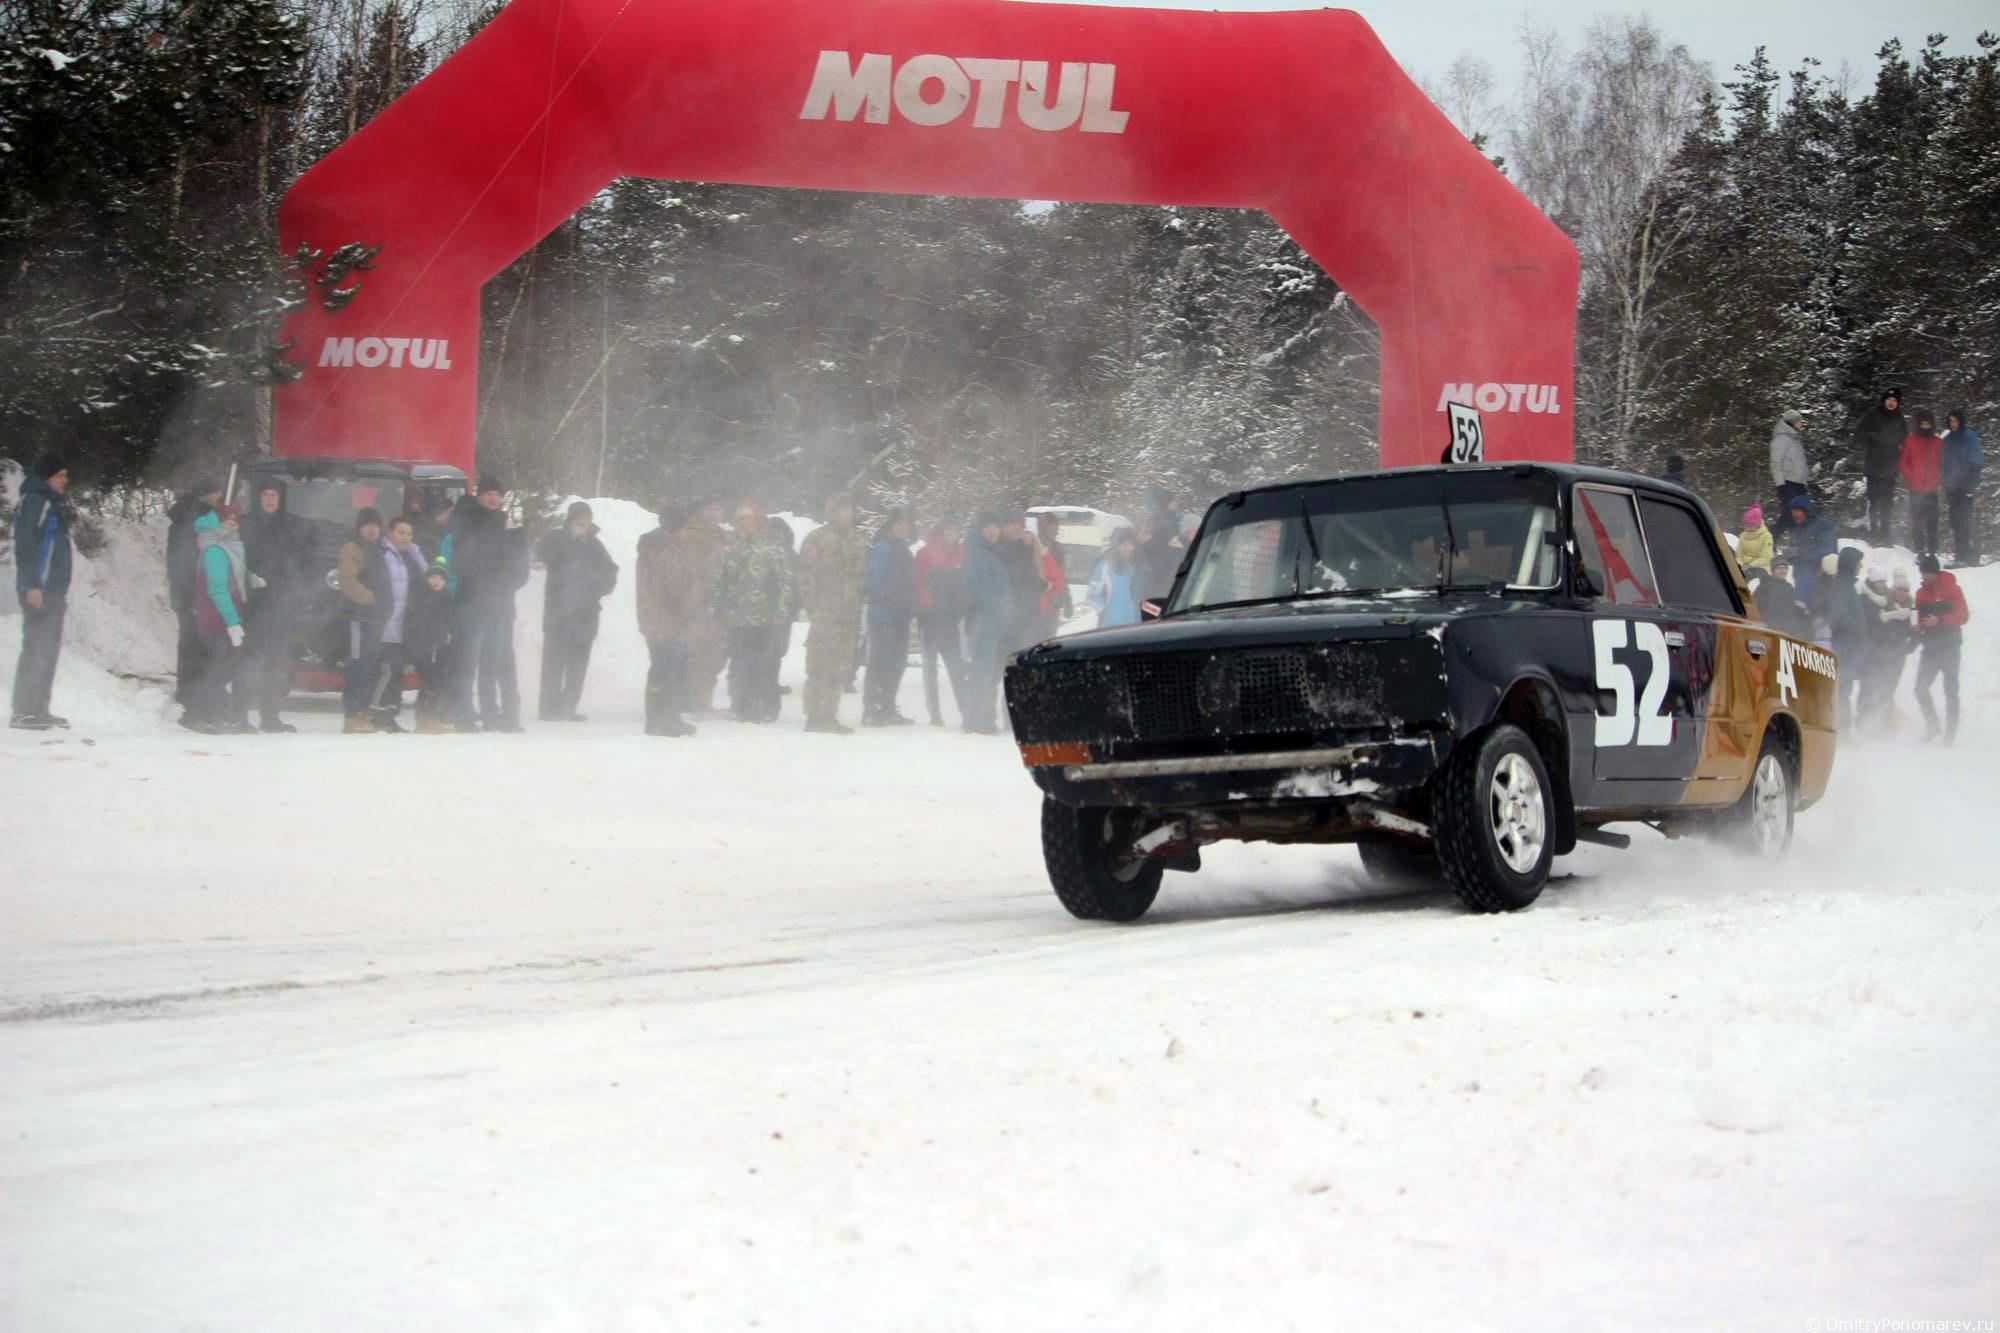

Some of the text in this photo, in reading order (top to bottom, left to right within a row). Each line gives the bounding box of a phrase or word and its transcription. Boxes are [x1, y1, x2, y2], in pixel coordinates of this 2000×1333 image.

[800, 50, 1131, 134] MOTUL
[318, 336, 452, 370] MOTUL
[1436, 382, 1561, 414] MOTUL
[1455, 416, 1479, 462] 52
[1592, 619, 1672, 747] 52
